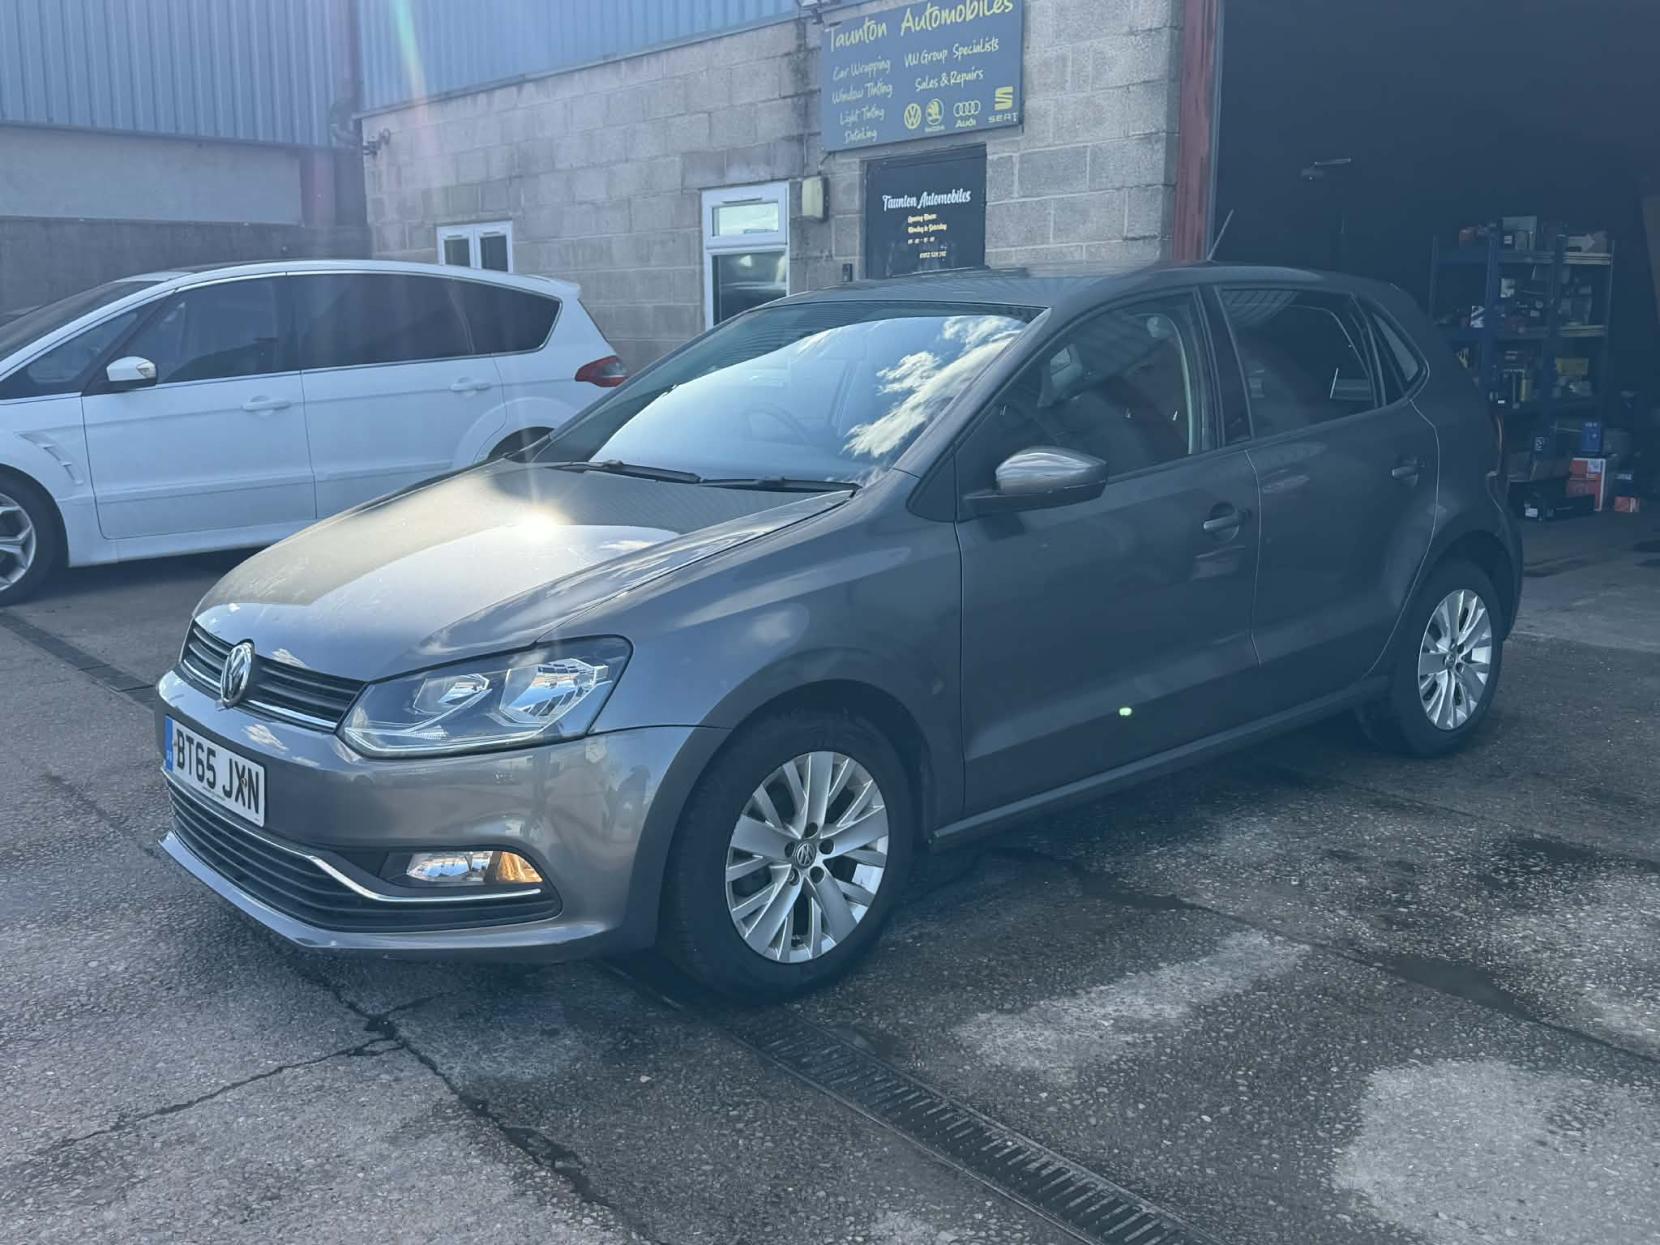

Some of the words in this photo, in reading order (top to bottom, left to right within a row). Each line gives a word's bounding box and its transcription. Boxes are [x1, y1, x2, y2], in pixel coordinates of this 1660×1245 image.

[825, 17, 887, 52] Taunton
[920, 49, 948, 64] Group
[915, 74, 939, 92] Sales
[939, 72, 950, 87] &
[950, 66, 984, 88] Repairs
[176, 728, 217, 790] BT65
[222, 757, 260, 814] JXN
